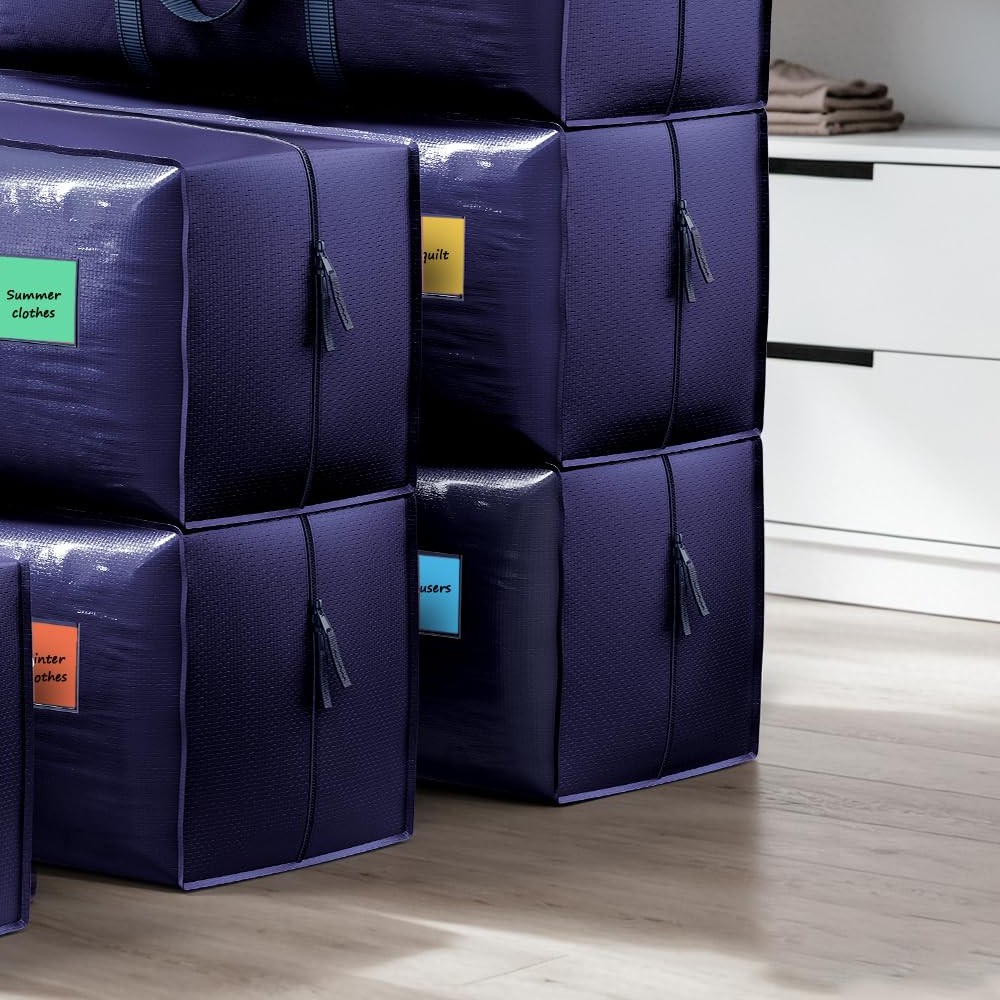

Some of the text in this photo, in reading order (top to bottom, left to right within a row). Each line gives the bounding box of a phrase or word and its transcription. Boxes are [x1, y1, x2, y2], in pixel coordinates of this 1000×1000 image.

[6, 289, 62, 301] Summer
[12, 306, 56, 319] clothes
[420, 584, 452, 593] users
[34, 652, 66, 664] inter
[34, 670, 68, 683] othes
